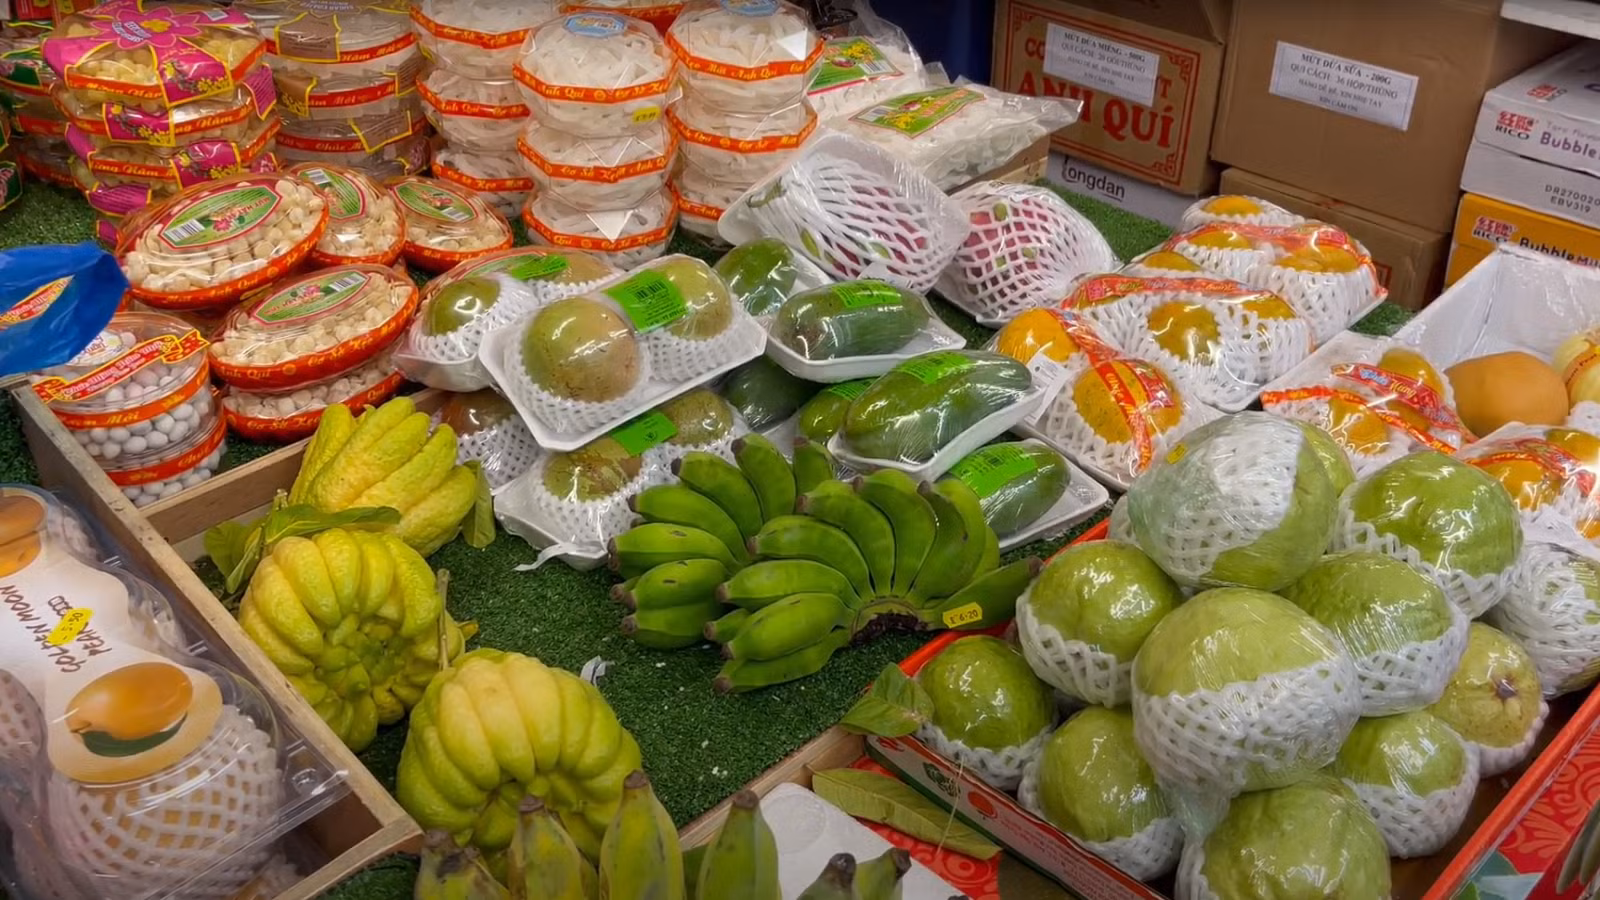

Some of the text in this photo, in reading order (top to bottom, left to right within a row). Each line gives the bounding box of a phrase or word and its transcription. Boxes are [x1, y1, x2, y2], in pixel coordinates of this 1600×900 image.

[1371, 73, 1391, 85] 200G
[1102, 99, 1174, 149] QUÍ
[1540, 131, 1597, 158] Bubble
[1061, 154, 1125, 200] Longdan
[0, 585, 41, 621] MOON
